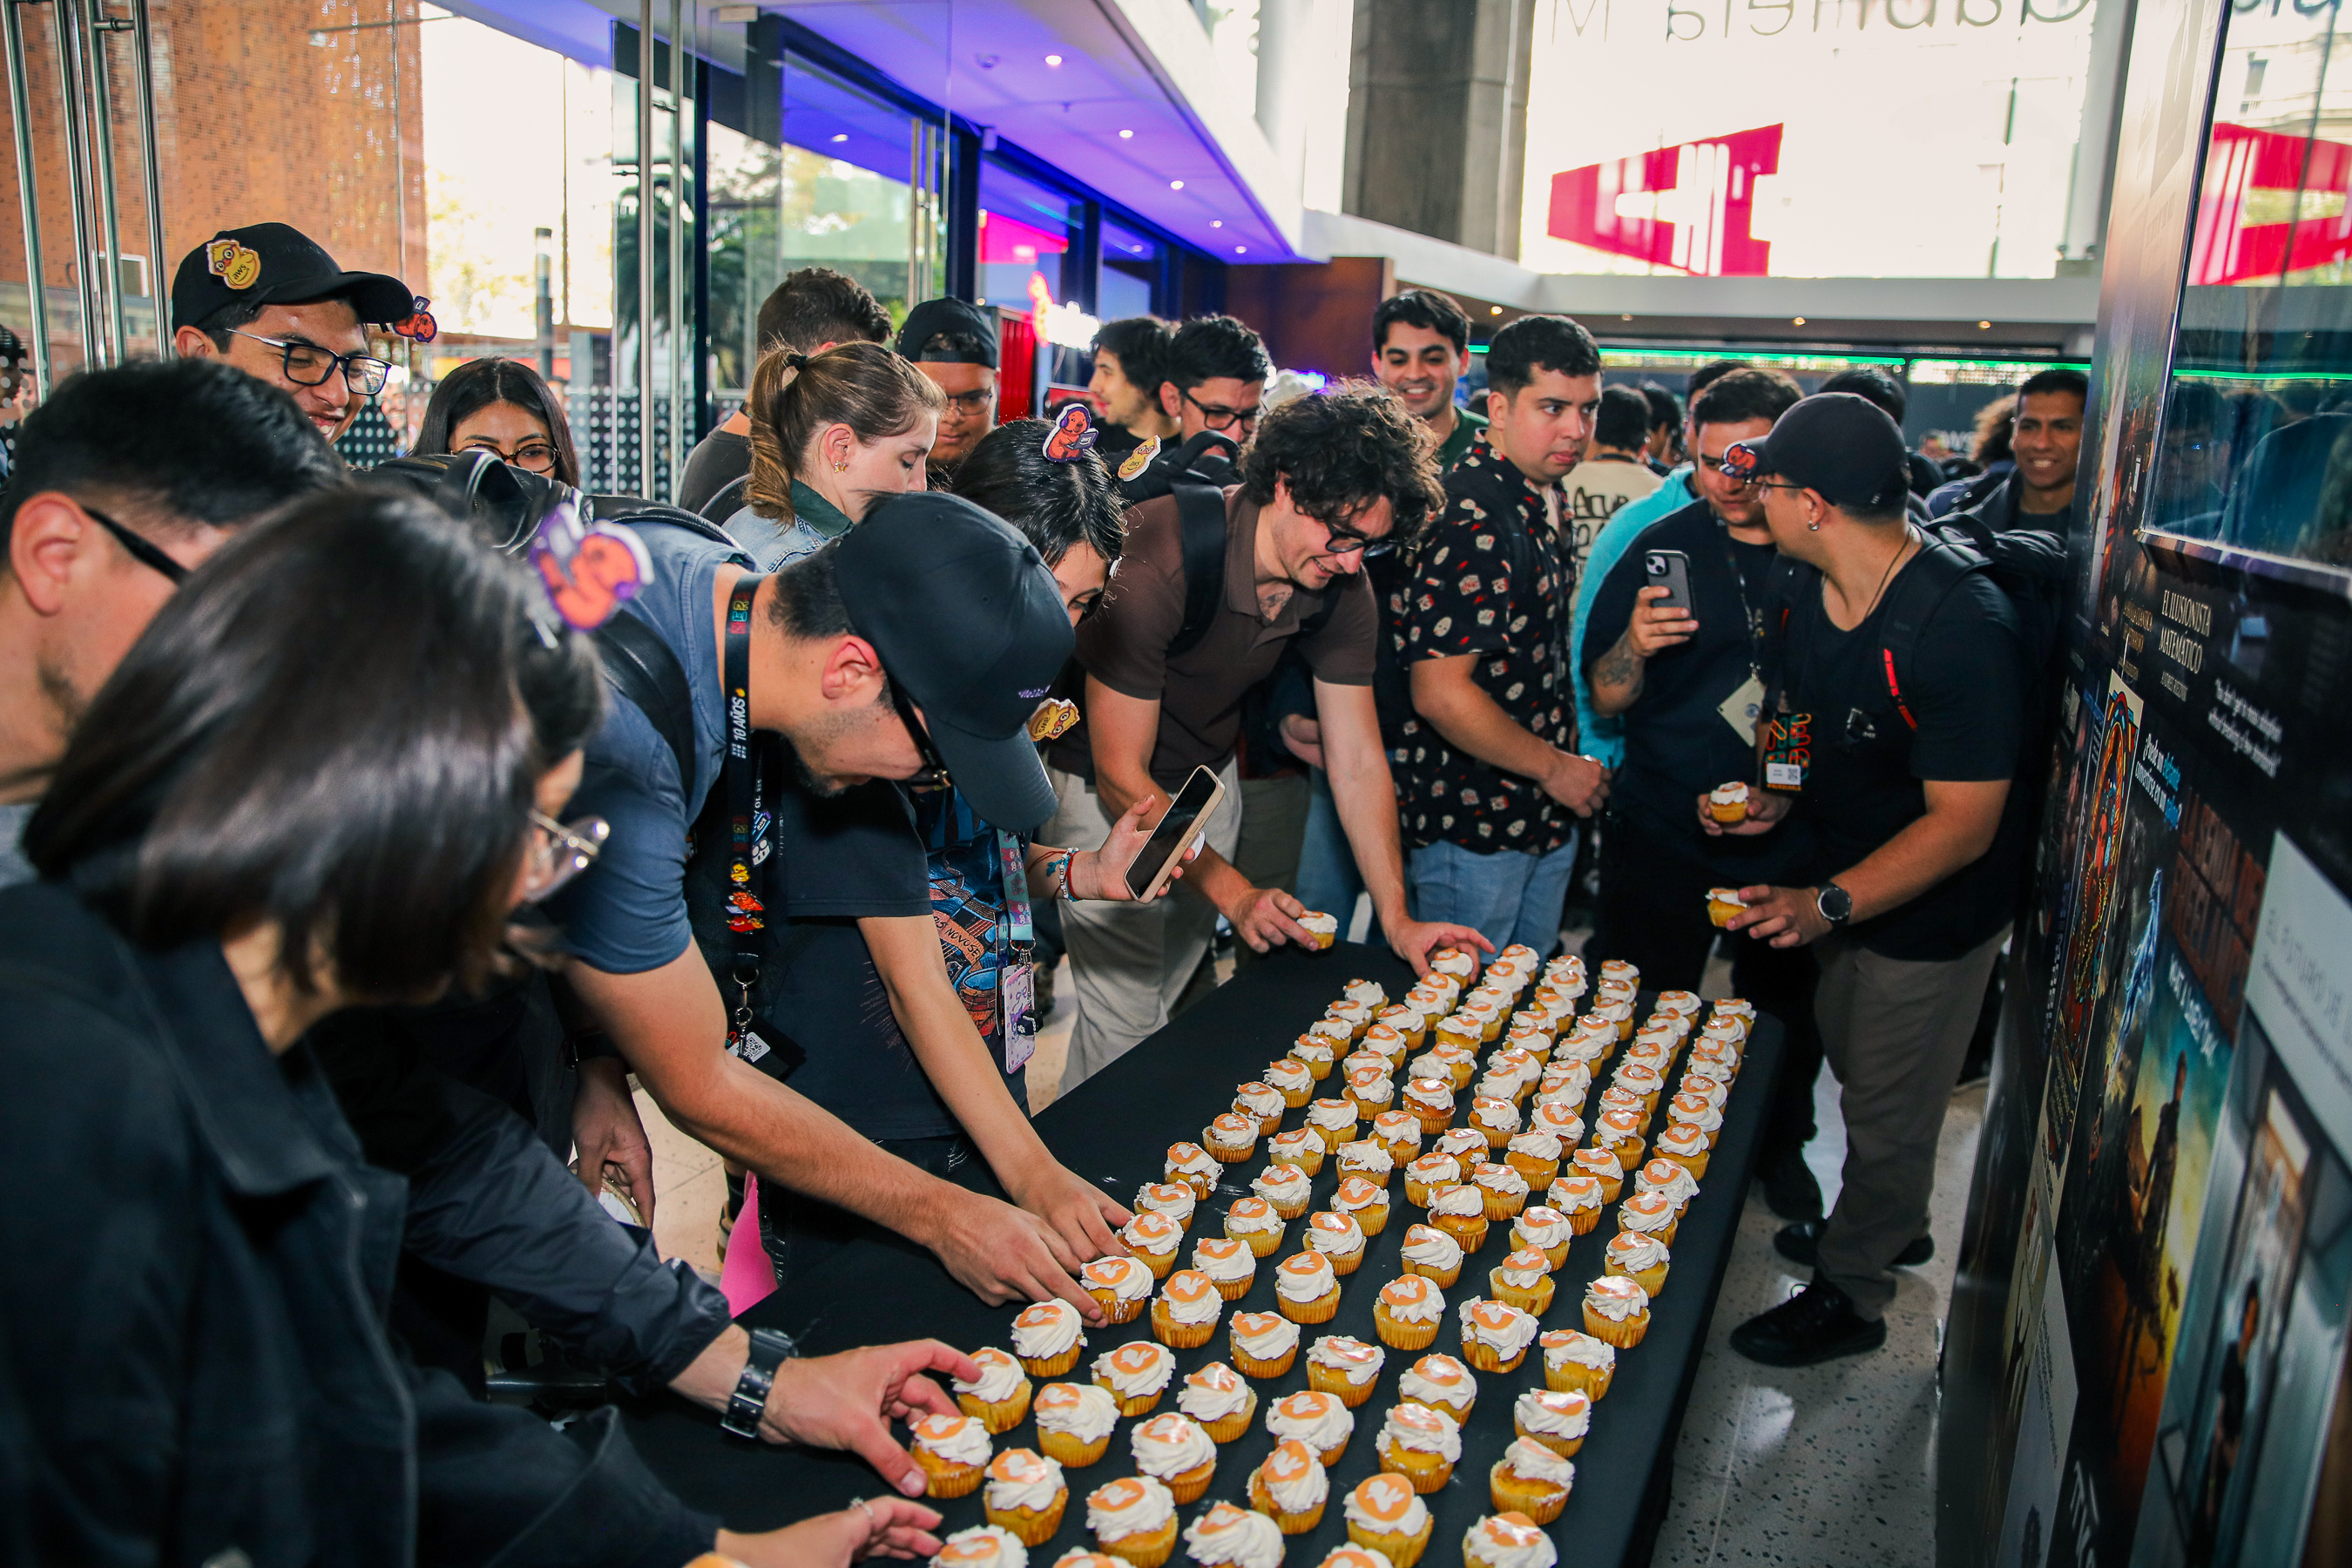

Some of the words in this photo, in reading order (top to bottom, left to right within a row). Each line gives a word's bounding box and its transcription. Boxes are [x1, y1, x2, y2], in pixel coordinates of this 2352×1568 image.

[2169, 592, 2212, 637] ILUSIONISTA
[2159, 625, 2203, 674] MATEMÁTICO
[729, 696, 747, 729] AÑOS
[733, 727, 747, 741] 10
